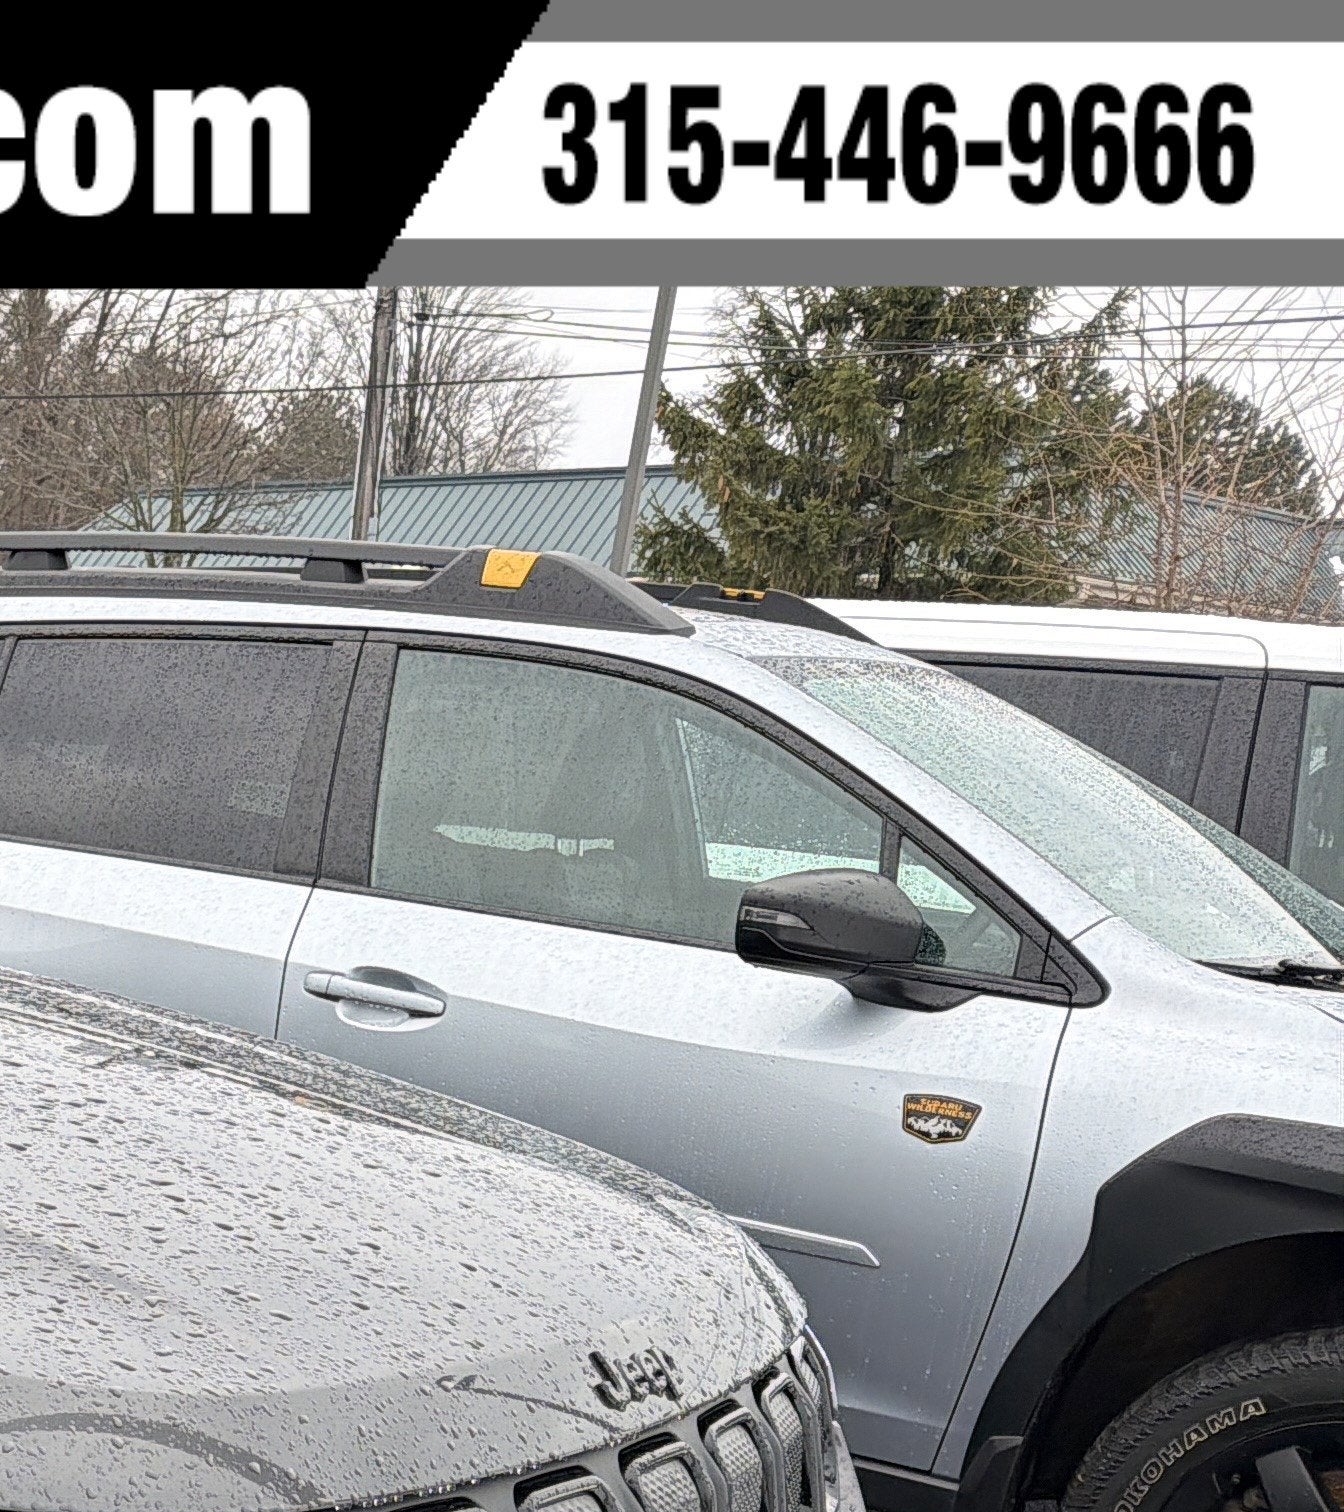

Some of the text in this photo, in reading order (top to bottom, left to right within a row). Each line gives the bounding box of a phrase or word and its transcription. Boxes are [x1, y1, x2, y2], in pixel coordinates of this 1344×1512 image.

[907, 1102, 973, 1119] WILDERNESS
[920, 1098, 963, 1110] SUBARU
[588, 1345, 681, 1412] Jeep
